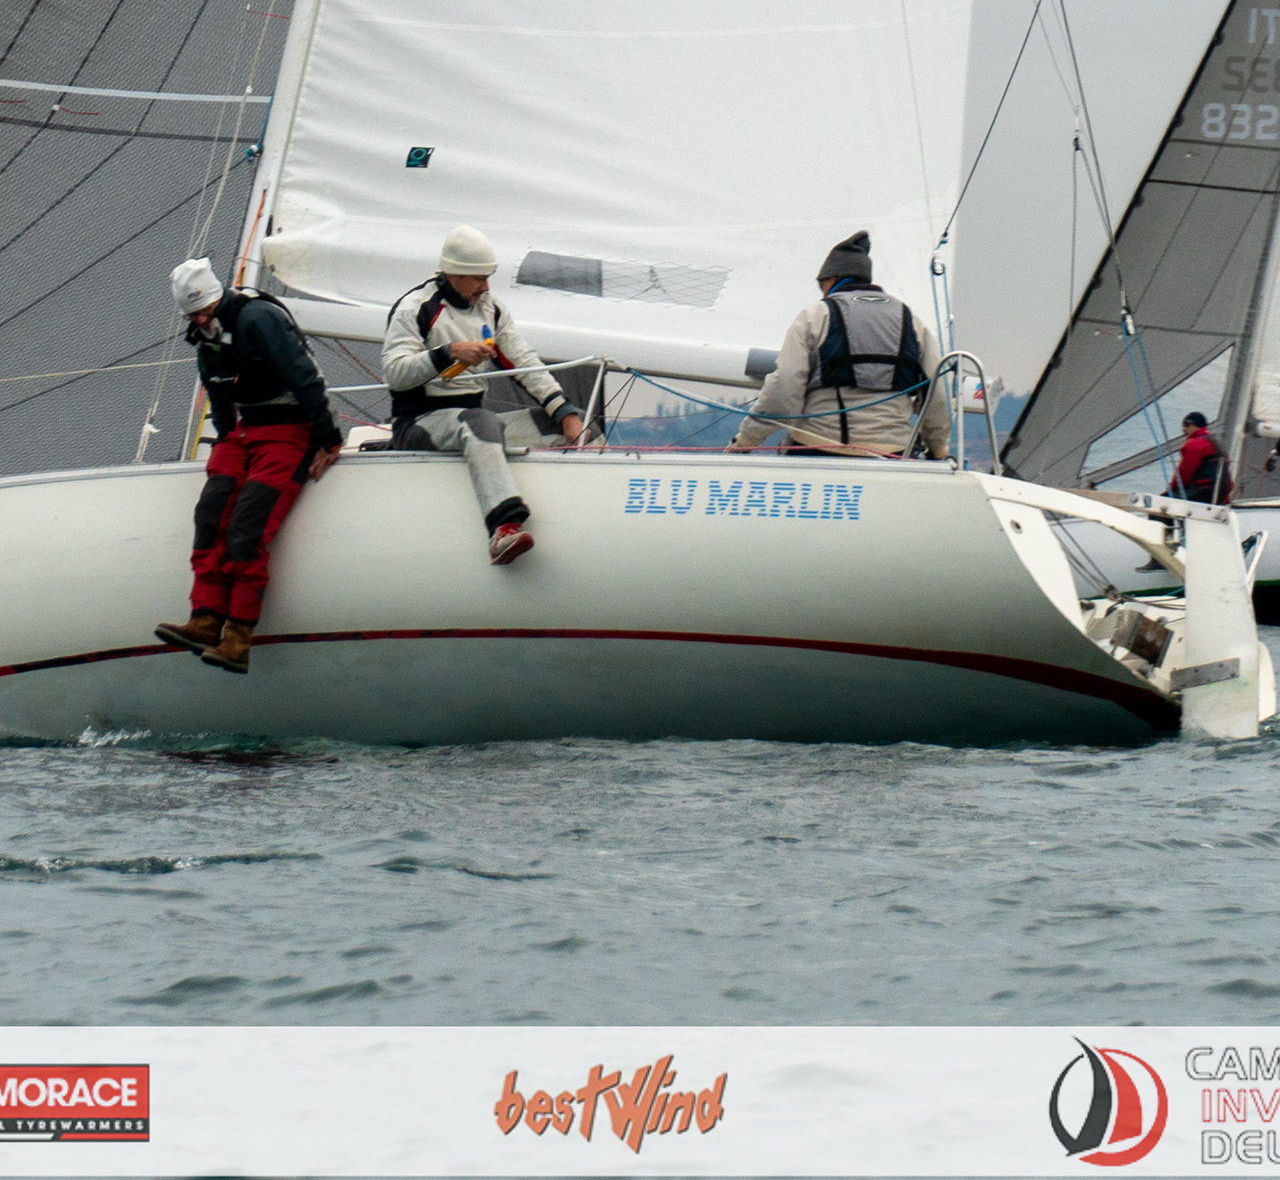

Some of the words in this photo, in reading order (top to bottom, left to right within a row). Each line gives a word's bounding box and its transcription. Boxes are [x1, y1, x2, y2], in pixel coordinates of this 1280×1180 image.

[1201, 102, 1280, 141] 832
[624, 478, 698, 515] BLU
[705, 480, 864, 521] MARLIN
